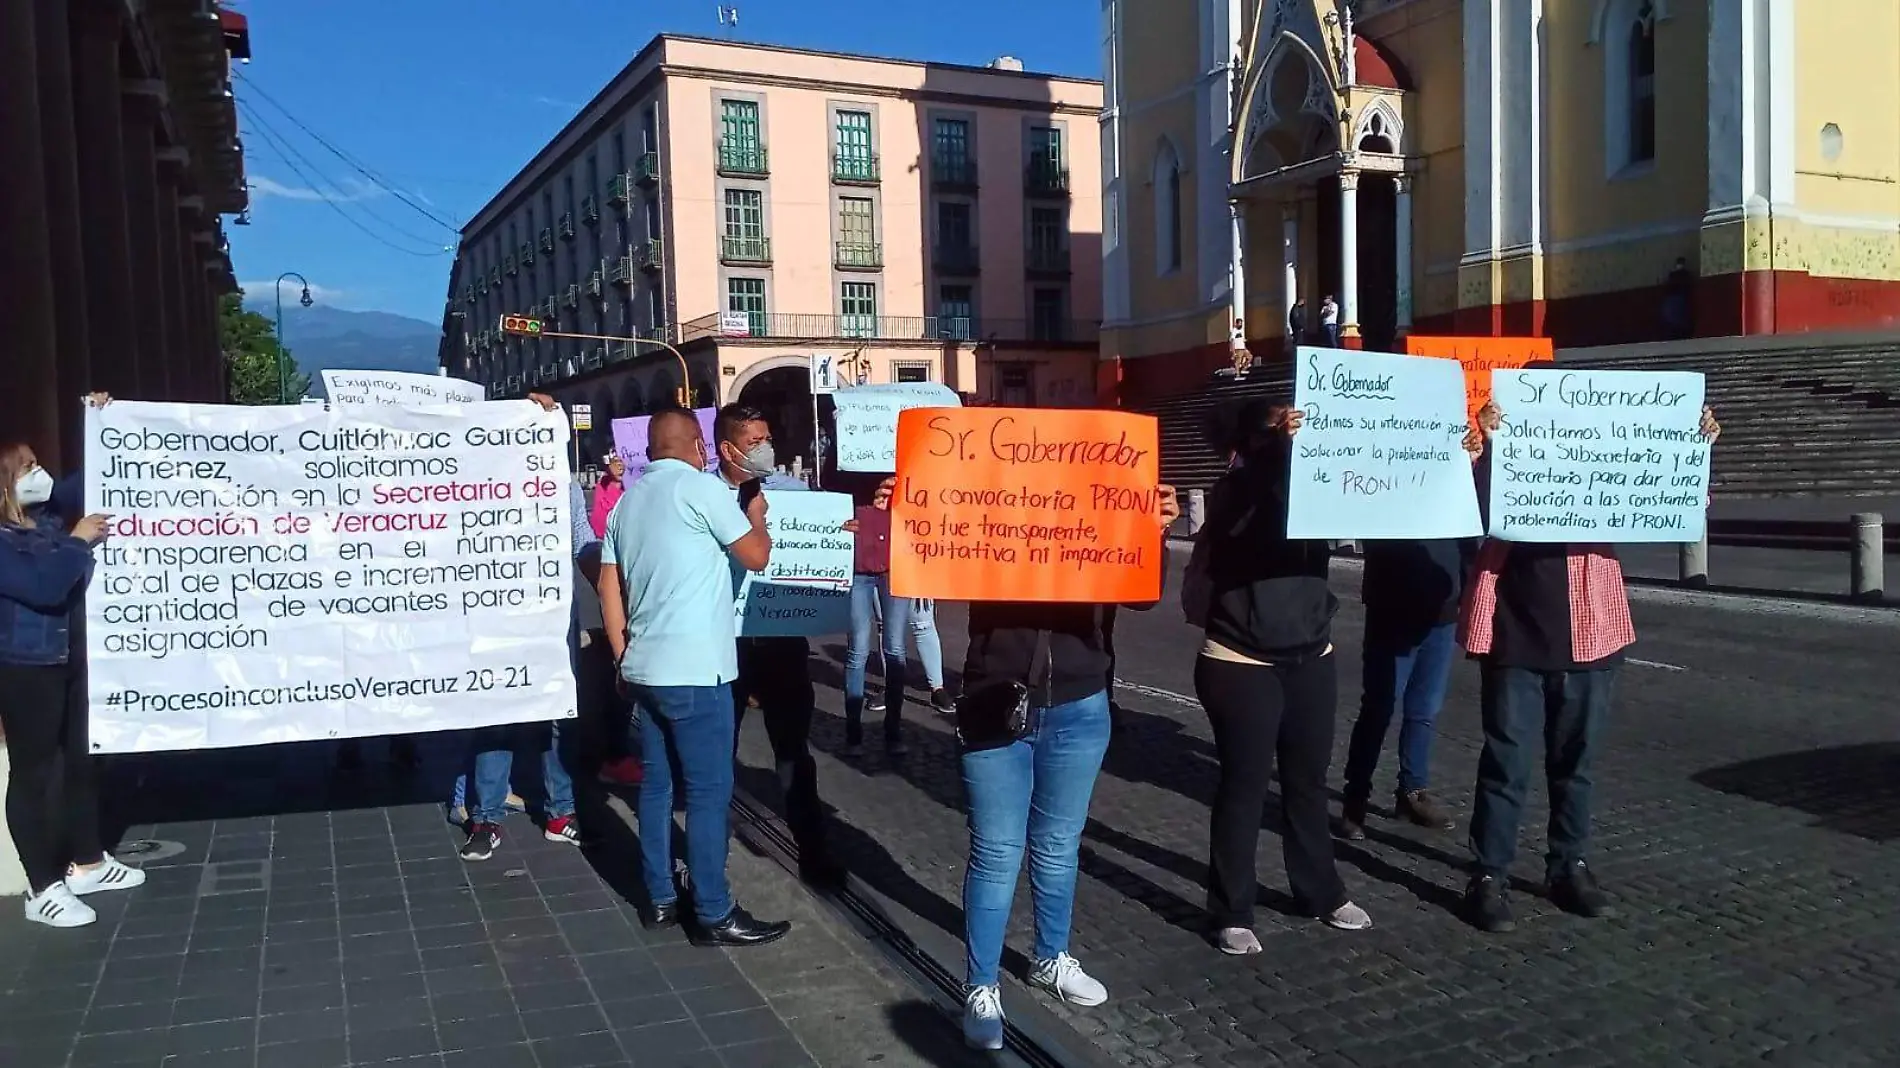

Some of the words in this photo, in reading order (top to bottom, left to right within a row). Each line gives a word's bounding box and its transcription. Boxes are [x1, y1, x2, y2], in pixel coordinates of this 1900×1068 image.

[332, 375, 401, 395] Exigimos
[410, 380, 437, 397] más
[1307, 353, 1326, 391] Sr.
[1332, 362, 1394, 392] Gobernador
[1518, 373, 1548, 403] Sr
[1558, 373, 1687, 408] Gobernador
[1304, 401, 1354, 431] Pedimos
[1360, 418, 1377, 431] su
[1499, 413, 1600, 440] Solicitamos
[1611, 421, 1627, 439] la
[1633, 422, 1711, 445] intervención
[100, 426, 285, 455] Gobernador,
[464, 422, 555, 447] García
[927, 415, 976, 461] Sr.
[990, 416, 1149, 469] Gobernador
[1372, 444, 1384, 460] la
[101, 454, 232, 483] Jiménez,
[304, 454, 458, 479] solicitamos
[526, 453, 555, 472] su
[1502, 442, 1522, 460] de
[1529, 443, 1546, 460] la
[1672, 451, 1681, 473] y
[1684, 450, 1705, 468] del
[1313, 467, 1331, 483] de
[1342, 470, 1399, 496] PRONI
[1503, 462, 1583, 486] Secretario
[1588, 469, 1628, 491] para
[1633, 469, 1663, 488] dar
[1671, 474, 1702, 488] una
[101, 482, 278, 509] intervención
[291, 488, 325, 508] en
[337, 482, 361, 506] la
[373, 477, 512, 505] Secretaria
[522, 475, 557, 498] de
[904, 477, 928, 509] La
[939, 486, 1076, 511] convocatoria
[1583, 495, 1593, 507] a
[1599, 491, 1621, 507] las
[1628, 490, 1700, 508] constantes
[273, 511, 311, 535] de
[460, 507, 523, 536] para
[763, 516, 773, 530] e
[779, 517, 842, 535] Educación
[904, 519, 932, 537] no
[977, 513, 1098, 547] transparente,
[1607, 512, 1626, 529] del
[1631, 512, 1687, 530] PRONI.
[339, 541, 374, 560] en
[456, 530, 560, 555] número
[910, 540, 1016, 565] quitativa
[1029, 545, 1049, 565] ni
[1059, 545, 1145, 571] imparcial
[181, 570, 220, 593] de
[231, 567, 323, 599] plazas
[334, 570, 352, 588] e
[363, 558, 527, 587] incrementar
[537, 555, 560, 578] la
[756, 585, 776, 599] del
[103, 596, 239, 624] cantidad
[267, 594, 306, 618] de
[317, 590, 449, 615] vacantes
[462, 588, 525, 616] para
[104, 623, 268, 660] asignación
[465, 664, 533, 692] 20-21
